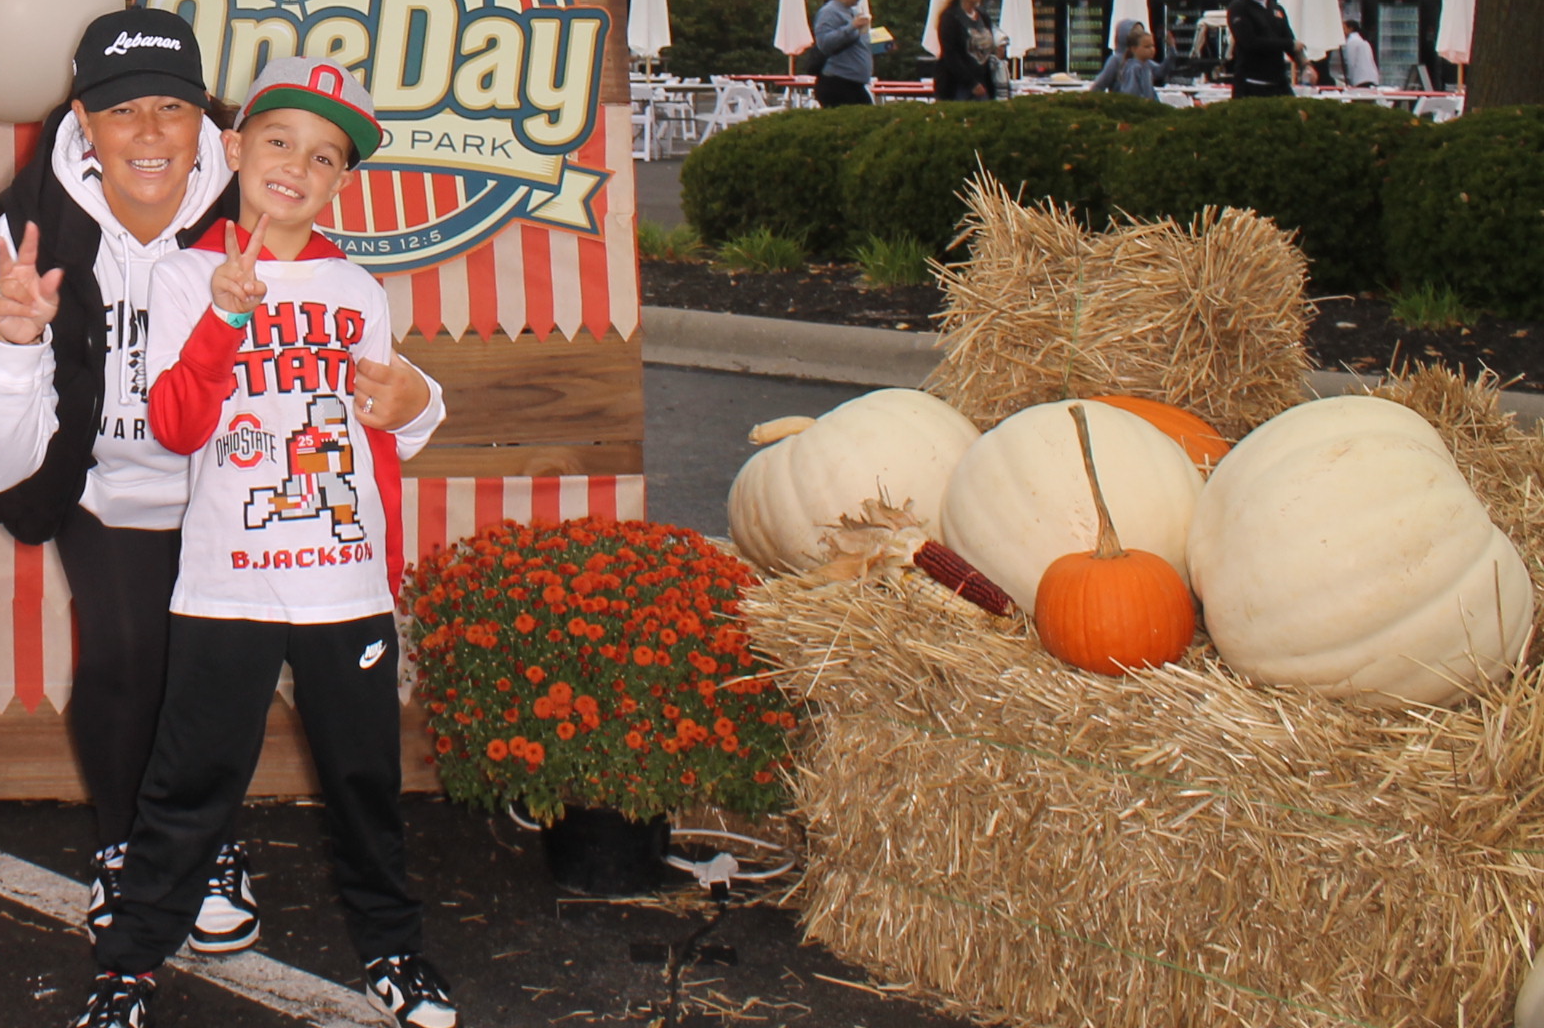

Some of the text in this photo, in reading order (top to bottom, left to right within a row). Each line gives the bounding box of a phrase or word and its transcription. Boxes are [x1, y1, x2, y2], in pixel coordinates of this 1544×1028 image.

[104, 30, 182, 56] Lebanon
[411, 129, 513, 159] PARK
[400, 229, 441, 250] 12:5
[238, 301, 365, 351] HIO
[224, 347, 355, 400] TAT
[298, 435, 314, 447] 25
[231, 542, 373, 569] B.JACKSON
